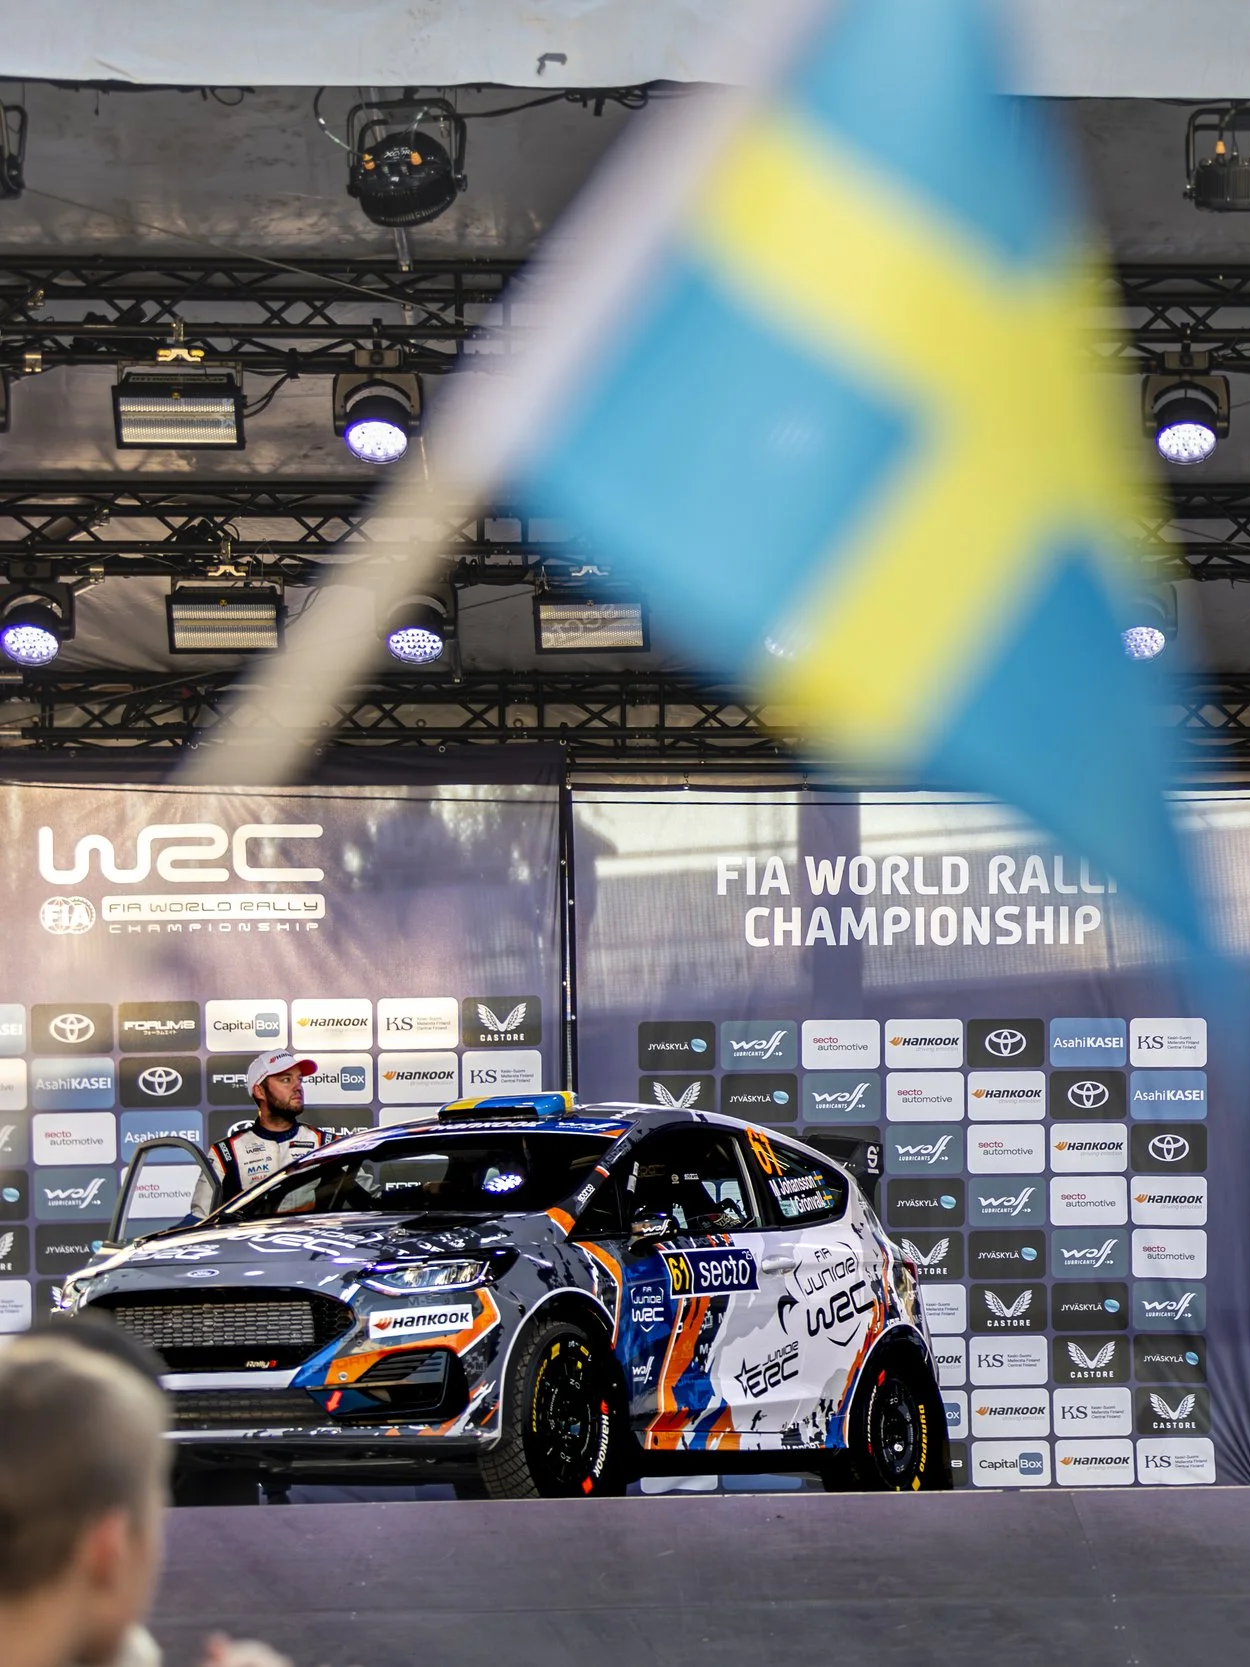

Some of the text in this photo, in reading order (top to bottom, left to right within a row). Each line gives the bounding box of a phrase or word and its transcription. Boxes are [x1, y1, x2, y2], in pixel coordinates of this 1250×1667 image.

[38, 823, 325, 885] WRC
[716, 855, 1117, 896] FIA WORLD RALL
[109, 901, 318, 913] FIA WORLD RALLY
[45, 903, 91, 929] FIA
[109, 922, 319, 934] CHAMPIONSHIP
[744, 905, 1102, 947] CHAMPIONSHIP
[123, 1019, 196, 1031] FORUM8
[213, 1018, 280, 1033] CapitalBox
[386, 1017, 413, 1031] KS
[648, 1041, 689, 1051] JYVÄSKYLÄ
[730, 1030, 788, 1059] wolf
[1053, 1037, 1124, 1048] AsahiKASEI
[1137, 1035, 1164, 1050] KS
[35, 1077, 111, 1090] AsahiKASEI
[469, 1069, 497, 1083] KS
[730, 1093, 771, 1103] JYVÄSKYLÄ
[812, 1082, 871, 1111] wolf
[1134, 1090, 1204, 1101] AsahiKASEI
[50, 1137, 104, 1146] automotive
[895, 1135, 953, 1163] wolf
[983, 1147, 1033, 1155] automotive
[247, 1164, 269, 1174] MAK
[44, 1178, 106, 1208] wolf
[578, 1184, 596, 1204] sparco
[769, 1175, 817, 1198] M Johansson
[138, 1191, 191, 1199] automotive
[793, 1189, 826, 1213] Grönvall
[978, 1187, 1036, 1216] wolf
[896, 1199, 938, 1208] JYVÄSKYLÄ
[642, 1219, 670, 1236] wolf
[814, 1248, 832, 1263] FIA
[977, 1250, 1019, 1259] JYVÄSKYLÄ
[1060, 1238, 1119, 1267] wolf
[1147, 1252, 1195, 1260] automotive
[668, 1257, 690, 1291] 61
[699, 1254, 749, 1287] secto
[804, 1256, 857, 1296] JUNIOR
[918, 1267, 948, 1275] STORE
[632, 1295, 663, 1304] JUNIOR
[1061, 1302, 1103, 1312] JYVÄSKYLÄ
[1142, 1292, 1198, 1320] wolf
[631, 1307, 664, 1322] WRC
[806, 1280, 876, 1337] WRC
[987, 1319, 1031, 1327] CASTORE
[762, 1340, 799, 1366] JUNIOR
[977, 1353, 1004, 1368] KS
[1143, 1354, 1184, 1363] JYVÄSKYLÄ
[632, 1356, 654, 1384] wolf
[746, 1352, 799, 1399] ERC
[1070, 1370, 1114, 1378] CASTORE
[1061, 1405, 1088, 1419] KS
[1152, 1421, 1196, 1429] CASTORE
[979, 1458, 1043, 1472] CapitalBox
[1145, 1454, 1171, 1469] KS
